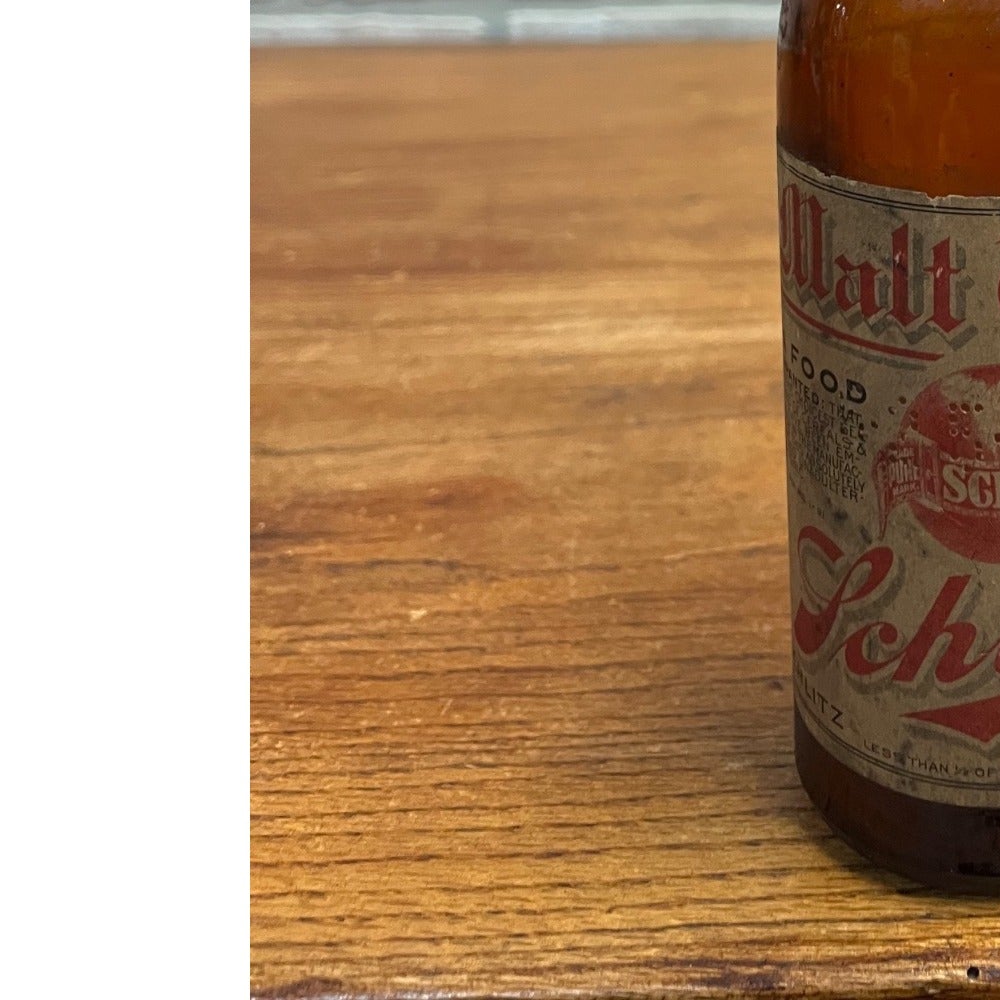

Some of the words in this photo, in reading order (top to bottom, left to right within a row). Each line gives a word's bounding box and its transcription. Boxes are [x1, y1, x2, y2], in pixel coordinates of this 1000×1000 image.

[779, 183, 967, 334] Malt
[790, 343, 867, 405] FOOD
[908, 755, 950, 774] THAN
